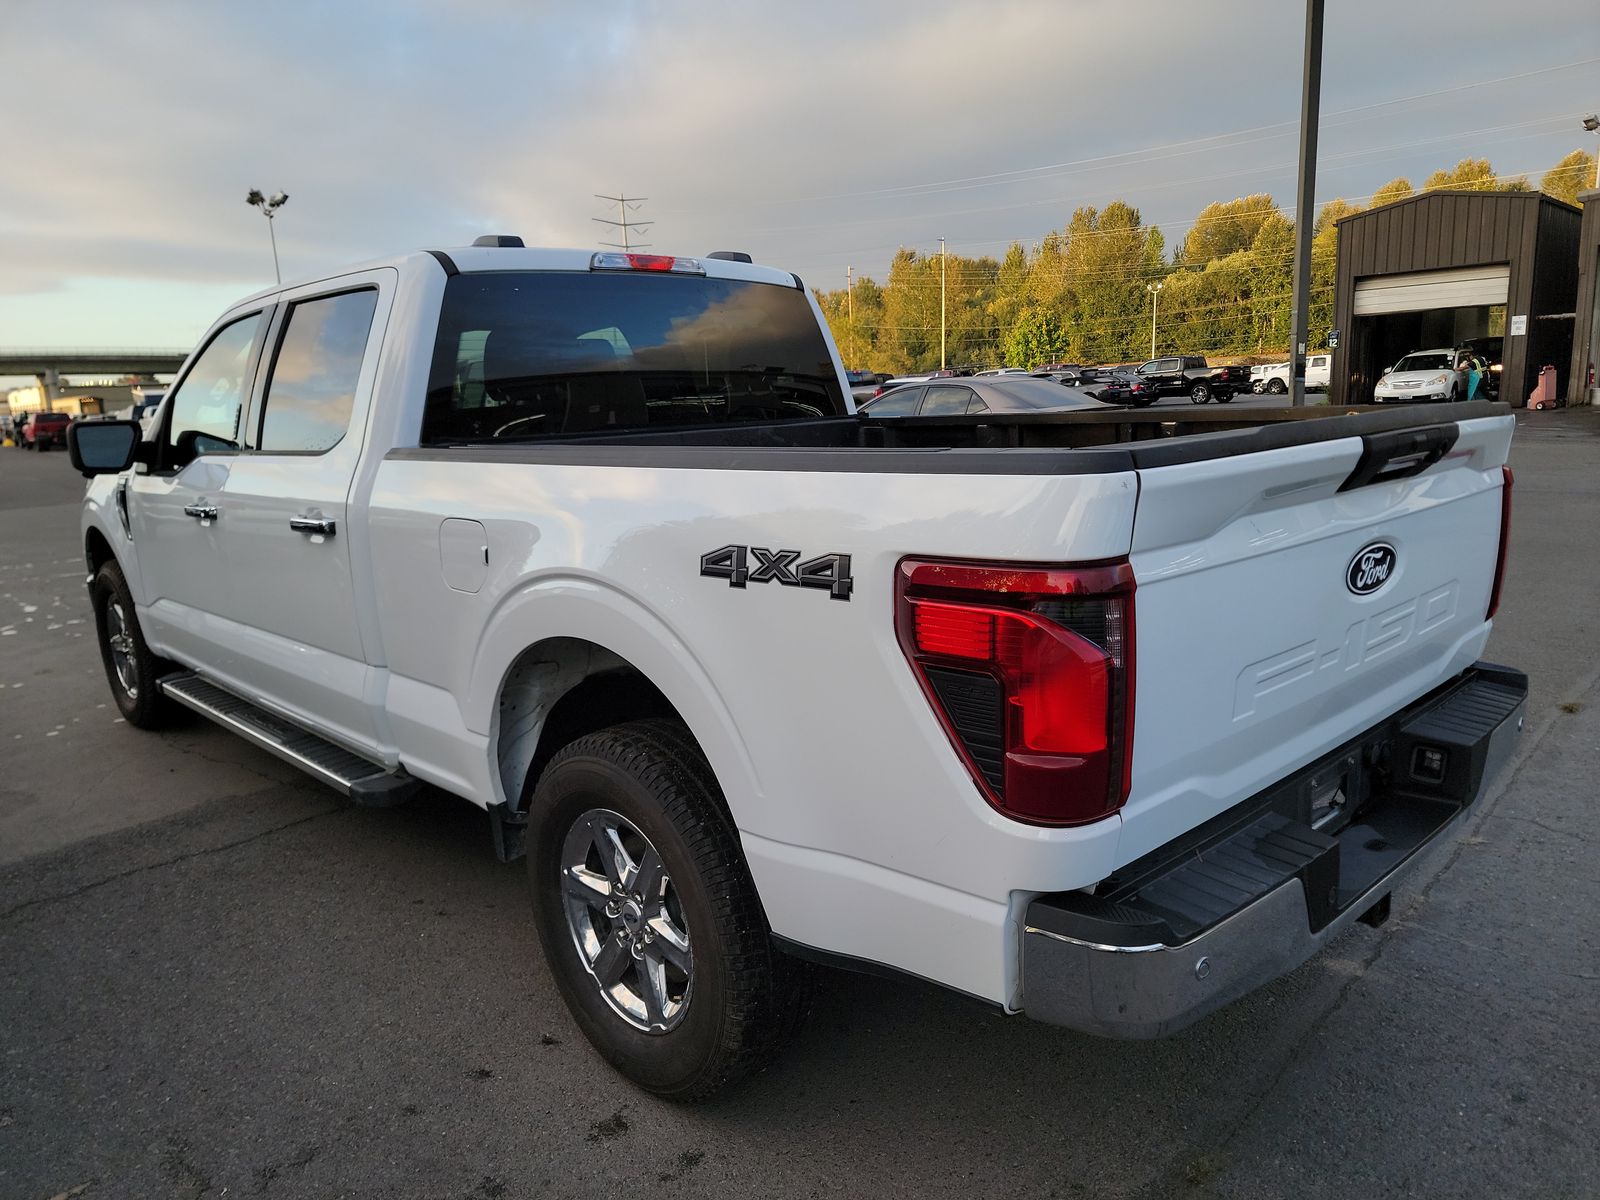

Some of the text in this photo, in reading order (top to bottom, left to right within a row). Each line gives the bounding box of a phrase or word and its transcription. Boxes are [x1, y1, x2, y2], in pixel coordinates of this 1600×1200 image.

[1328, 338, 1338, 347] 12
[1356, 550, 1391, 588] Ford
[1232, 579, 1459, 722] F-150
